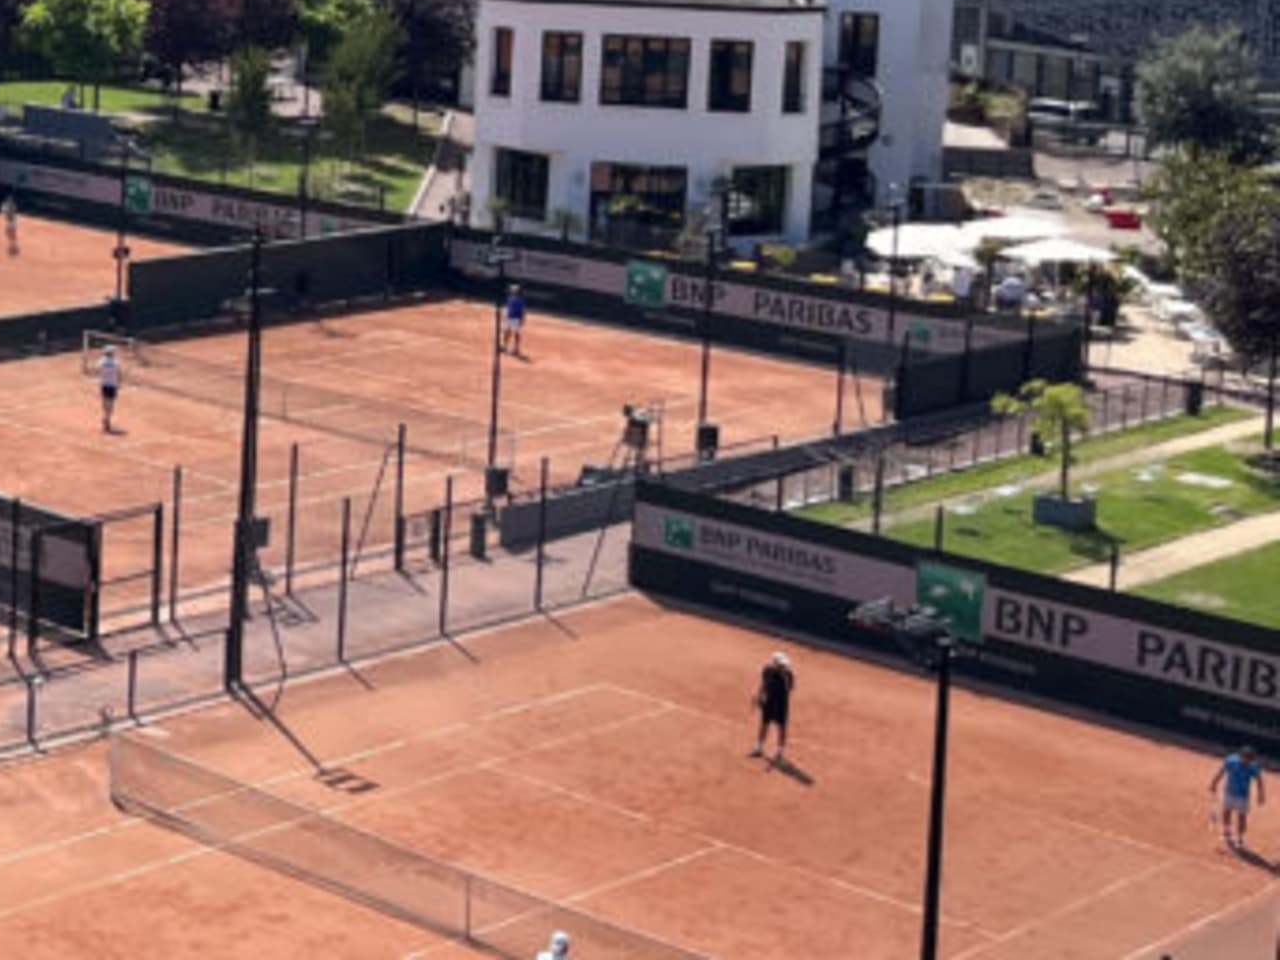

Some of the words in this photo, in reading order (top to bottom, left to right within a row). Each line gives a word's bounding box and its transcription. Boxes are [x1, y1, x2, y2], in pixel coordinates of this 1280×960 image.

[670, 277, 726, 306] BNP
[753, 291, 873, 335] PARIBAS
[700, 524, 741, 549] BNP
[746, 536, 836, 574] PARIBAS
[993, 596, 1088, 647] BNP
[1136, 630, 1279, 699] PARIB
